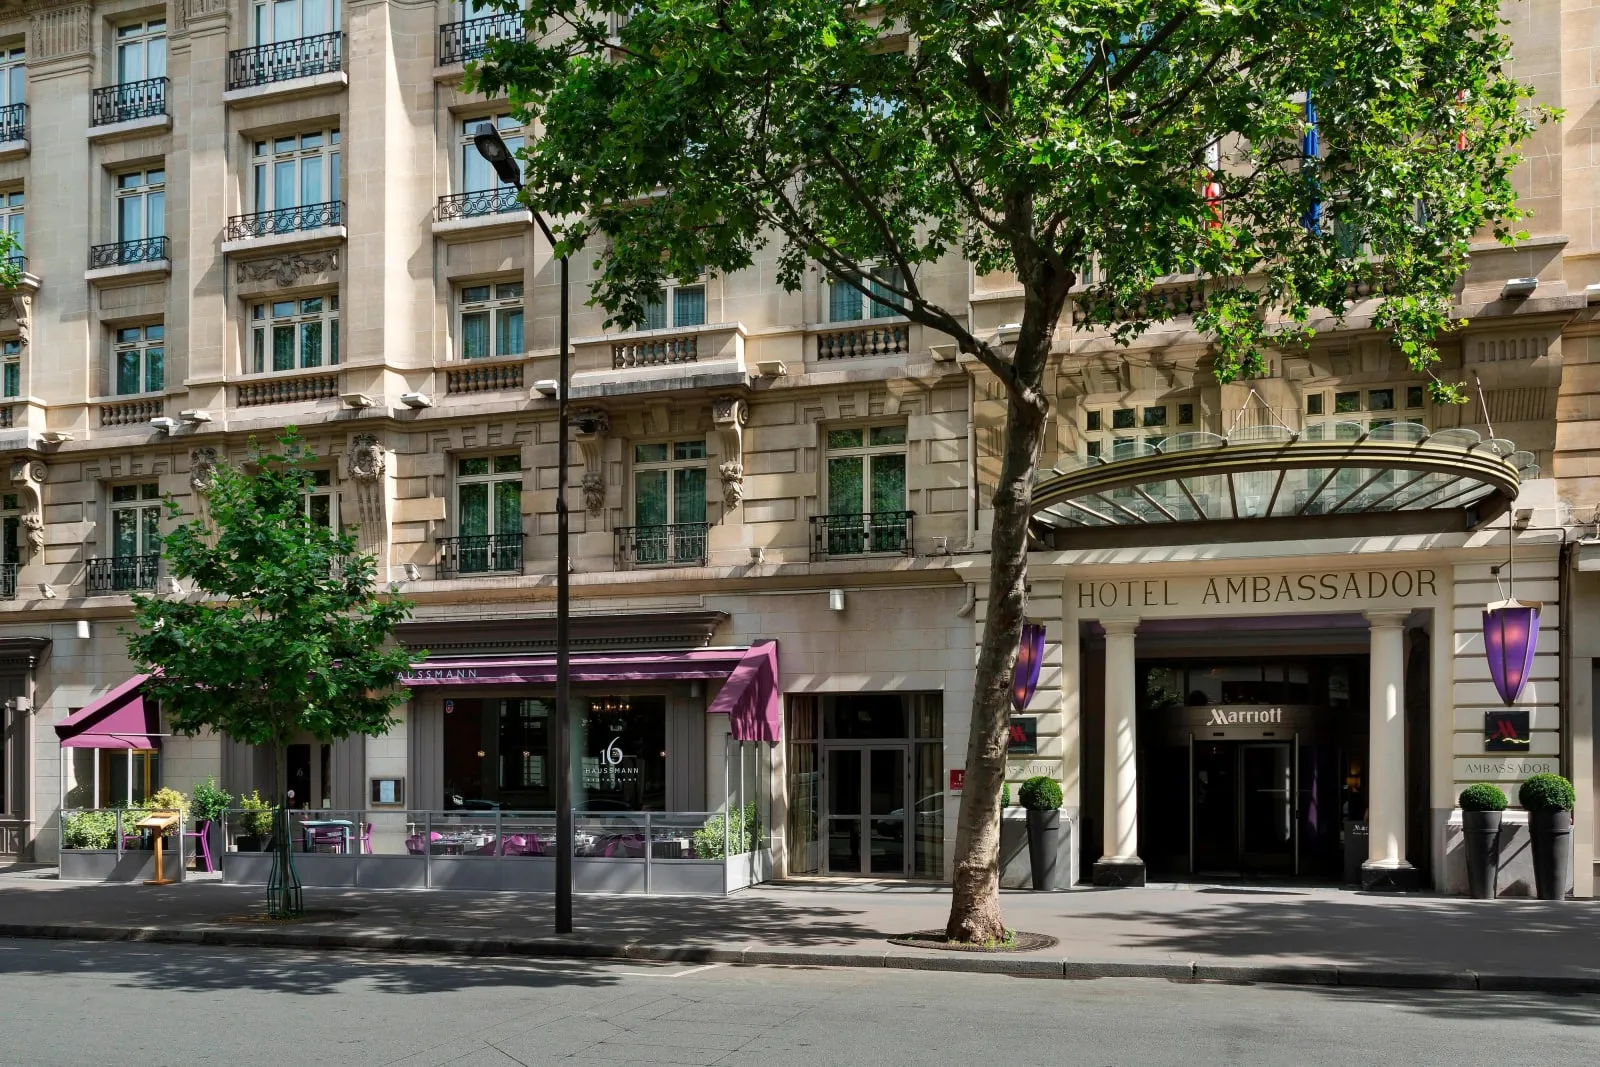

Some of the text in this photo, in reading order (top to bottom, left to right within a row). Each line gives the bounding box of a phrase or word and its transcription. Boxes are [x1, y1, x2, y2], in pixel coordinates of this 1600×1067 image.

[1078, 569, 1437, 609] HOTEL AMBASSADOR
[391, 669, 477, 680] AUSSMANN
[1206, 708, 1282, 726] Marriott
[599, 736, 623, 765] 16
[1005, 765, 1054, 774] ASSADOR
[1464, 763, 1550, 774] AMBASSADOR
